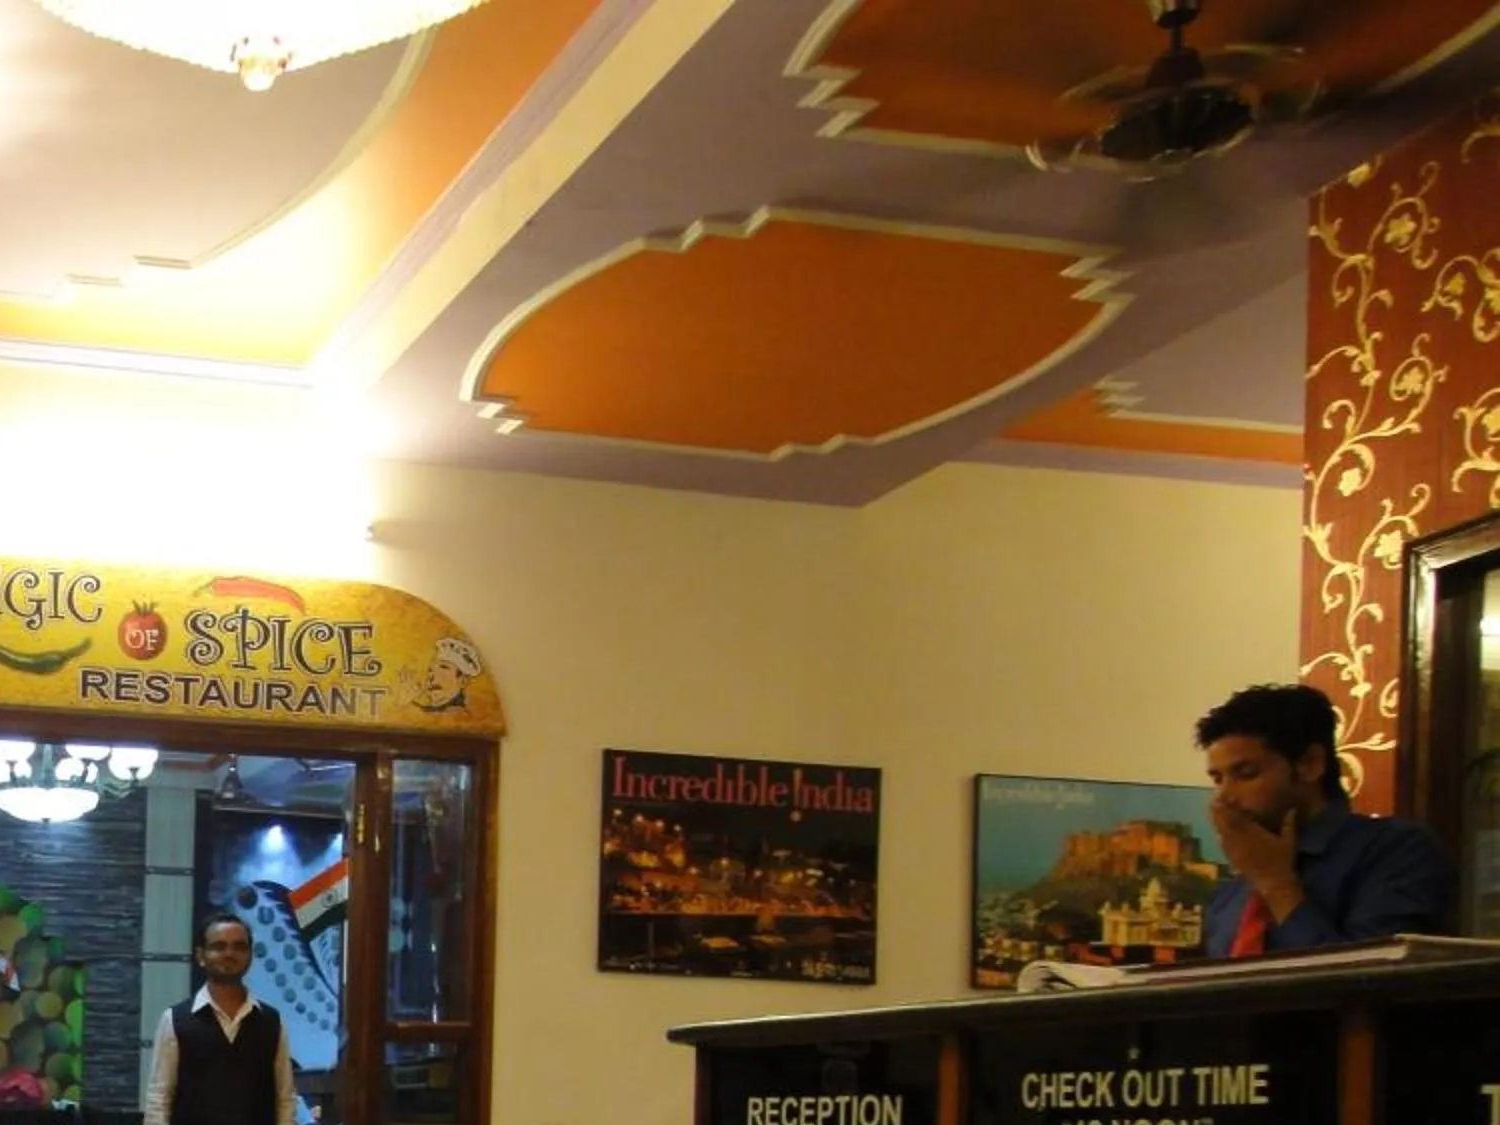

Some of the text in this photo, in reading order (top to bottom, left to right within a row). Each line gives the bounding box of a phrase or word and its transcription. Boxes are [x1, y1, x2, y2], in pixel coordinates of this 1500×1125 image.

[124, 627, 160, 652] OF
[184, 604, 383, 678] SPICE
[78, 667, 387, 718] RESTAURANT
[611, 755, 789, 808] Incredible
[1021, 1063, 1270, 1108] CHECK OUT TIME
